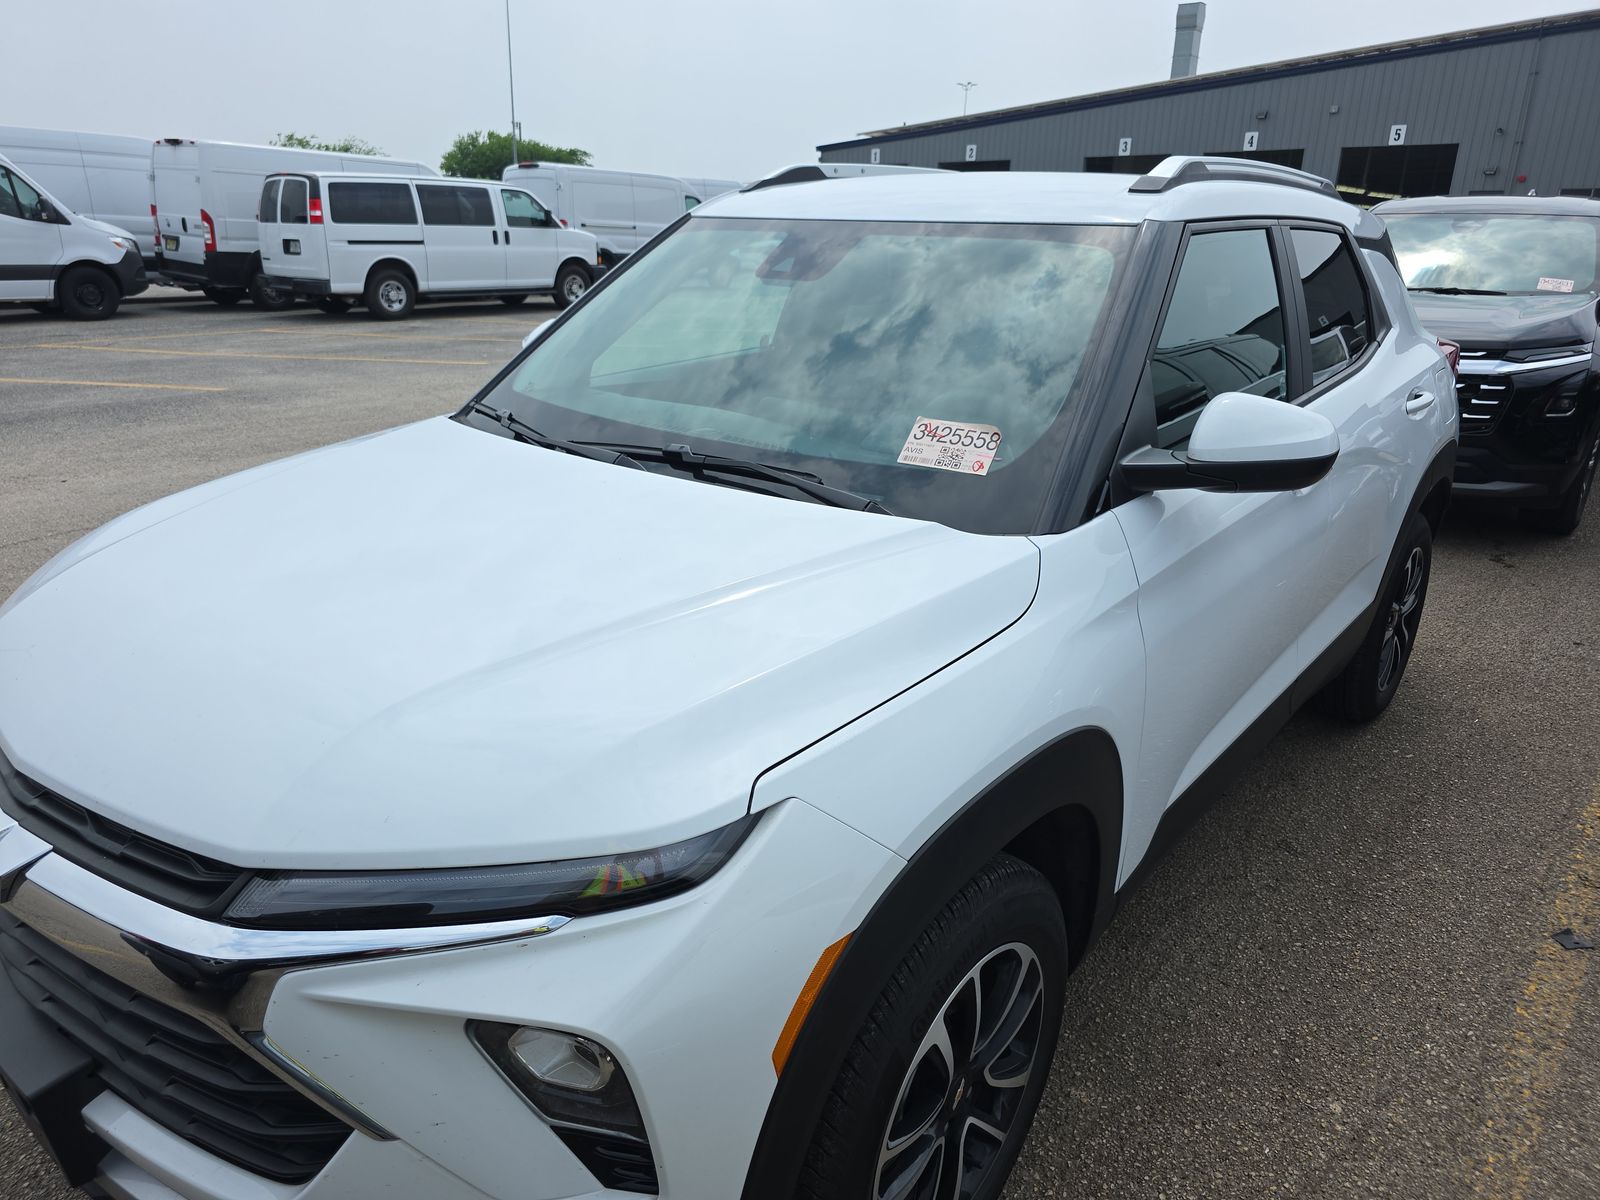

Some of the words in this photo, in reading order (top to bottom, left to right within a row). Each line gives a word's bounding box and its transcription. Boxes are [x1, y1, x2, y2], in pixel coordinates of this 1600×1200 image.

[1393, 128, 1402, 142] 5
[1121, 141, 1128, 153] 3
[1247, 135, 1255, 148] 4
[968, 147, 974, 159] 2
[913, 423, 1001, 451] 3425558
[903, 446, 924, 455] AVIS
